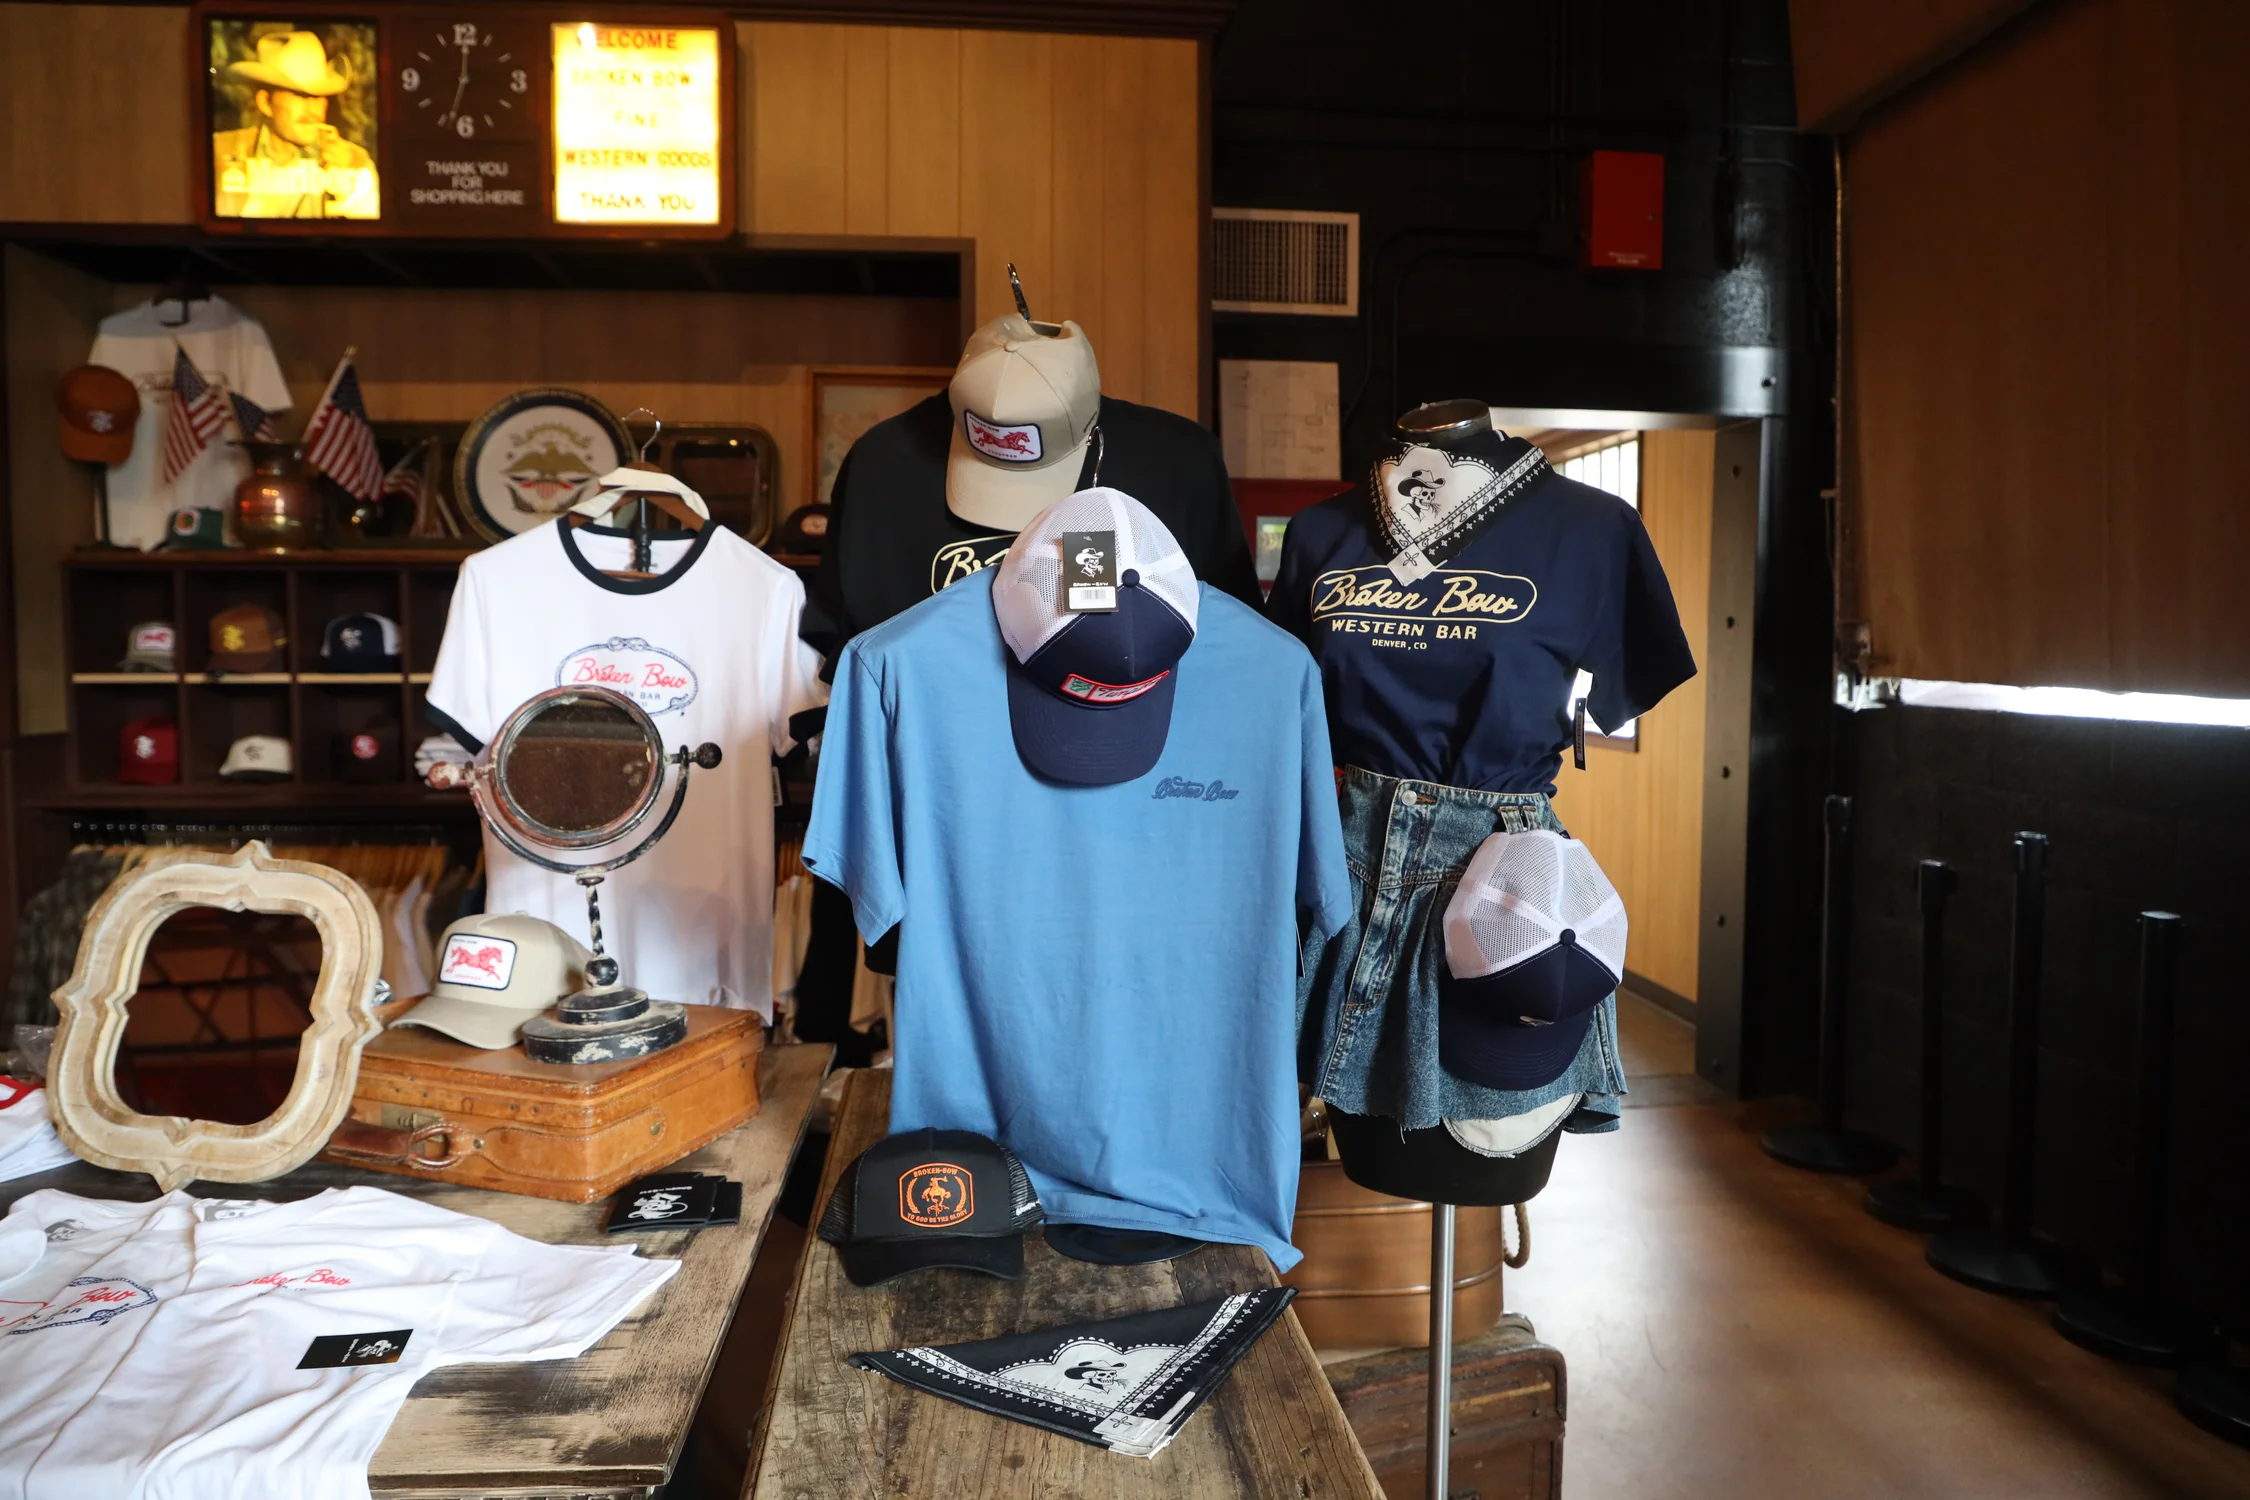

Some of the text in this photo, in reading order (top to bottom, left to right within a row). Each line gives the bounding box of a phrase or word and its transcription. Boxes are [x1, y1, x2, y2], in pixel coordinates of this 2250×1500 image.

[452, 22, 477, 46] 12
[401, 67, 528, 94] 9 3
[456, 114, 475, 138] 6
[565, 151, 648, 167] WESTERN
[426, 161, 509, 177] THANK YOU
[452, 174, 483, 190] FOR
[580, 192, 696, 210] THANK YOU
[1314, 573, 1518, 616] Broken Bow
[1331, 619, 1478, 640] WESTERN BAR
[572, 657, 688, 688] Broken Bow
[640, 691, 661, 700] BAR
[305, 1269, 351, 1285] Bow
